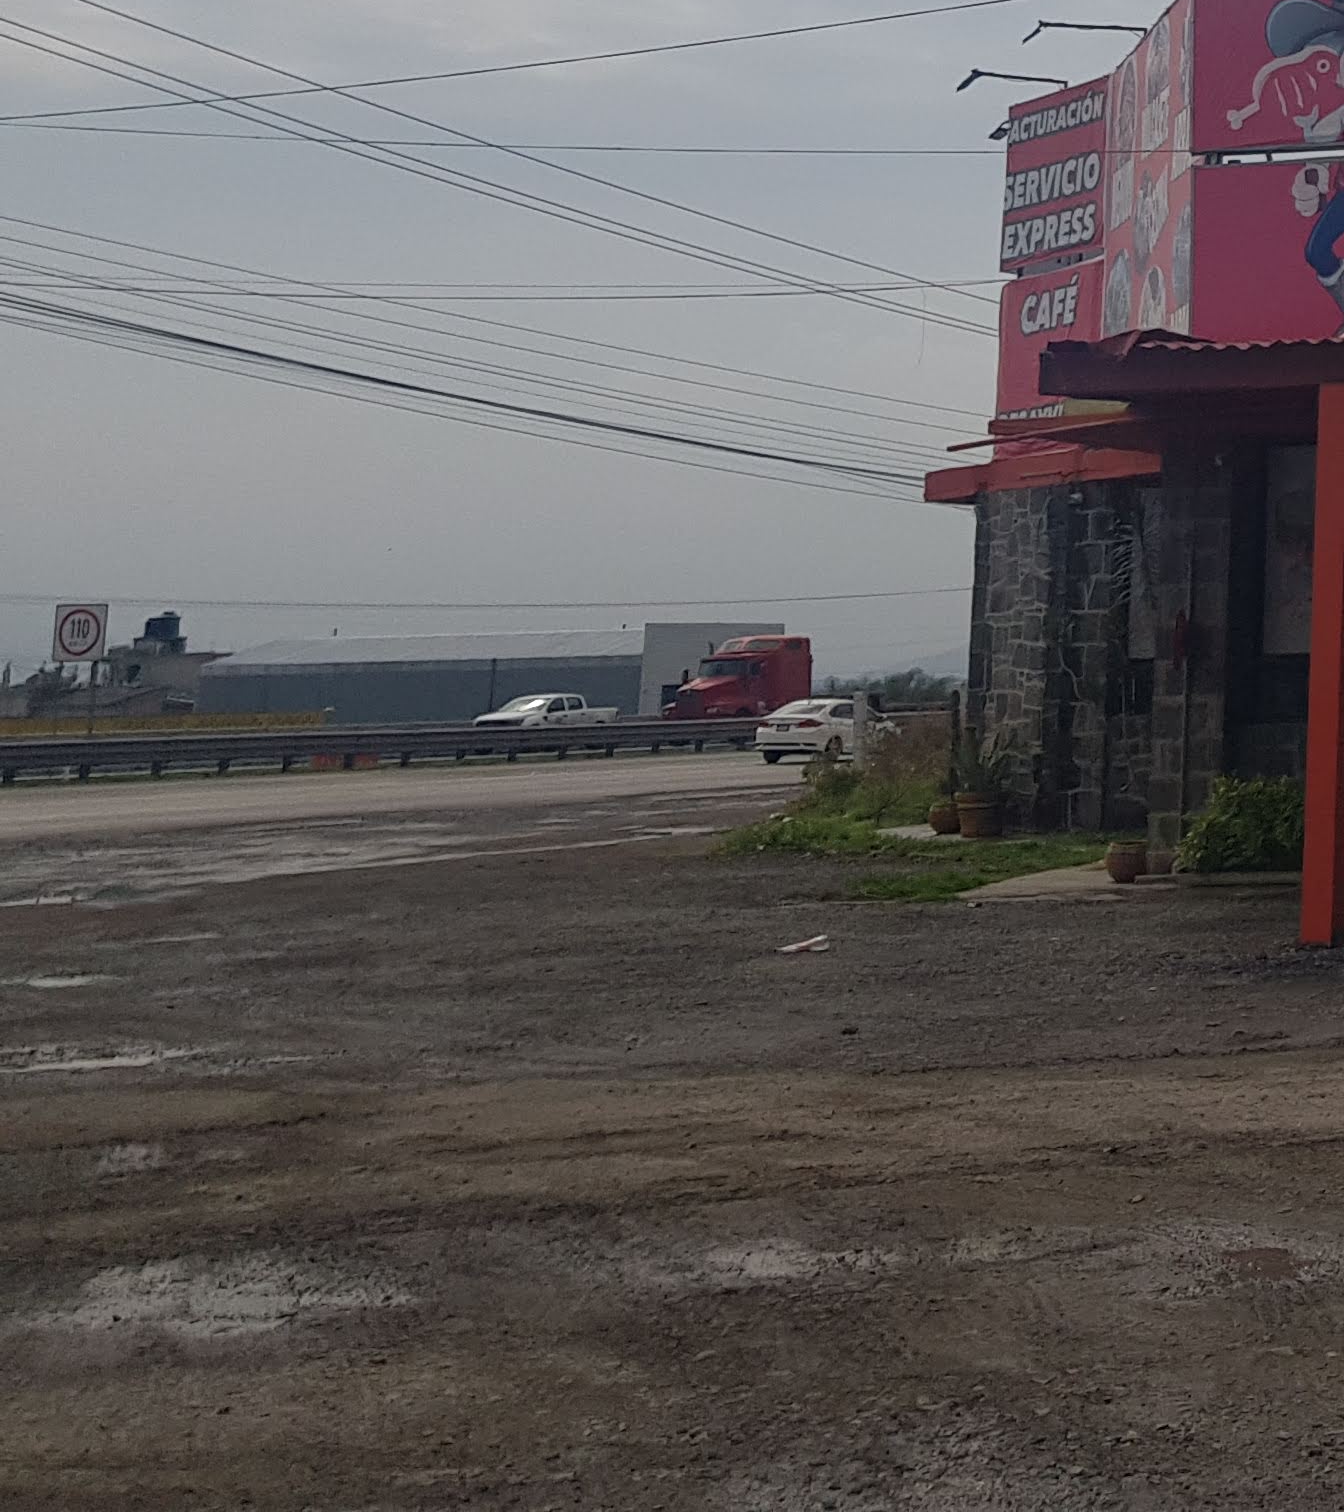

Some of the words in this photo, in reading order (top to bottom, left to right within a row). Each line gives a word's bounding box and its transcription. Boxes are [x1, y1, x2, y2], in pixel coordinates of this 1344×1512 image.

[1008, 91, 1104, 144] ACTURACIÓN
[1004, 151, 1102, 215] SERVICIO
[1001, 202, 1097, 261] EXPRESS
[1019, 273, 1080, 337] CAFÉ
[70, 617, 90, 639] 110
